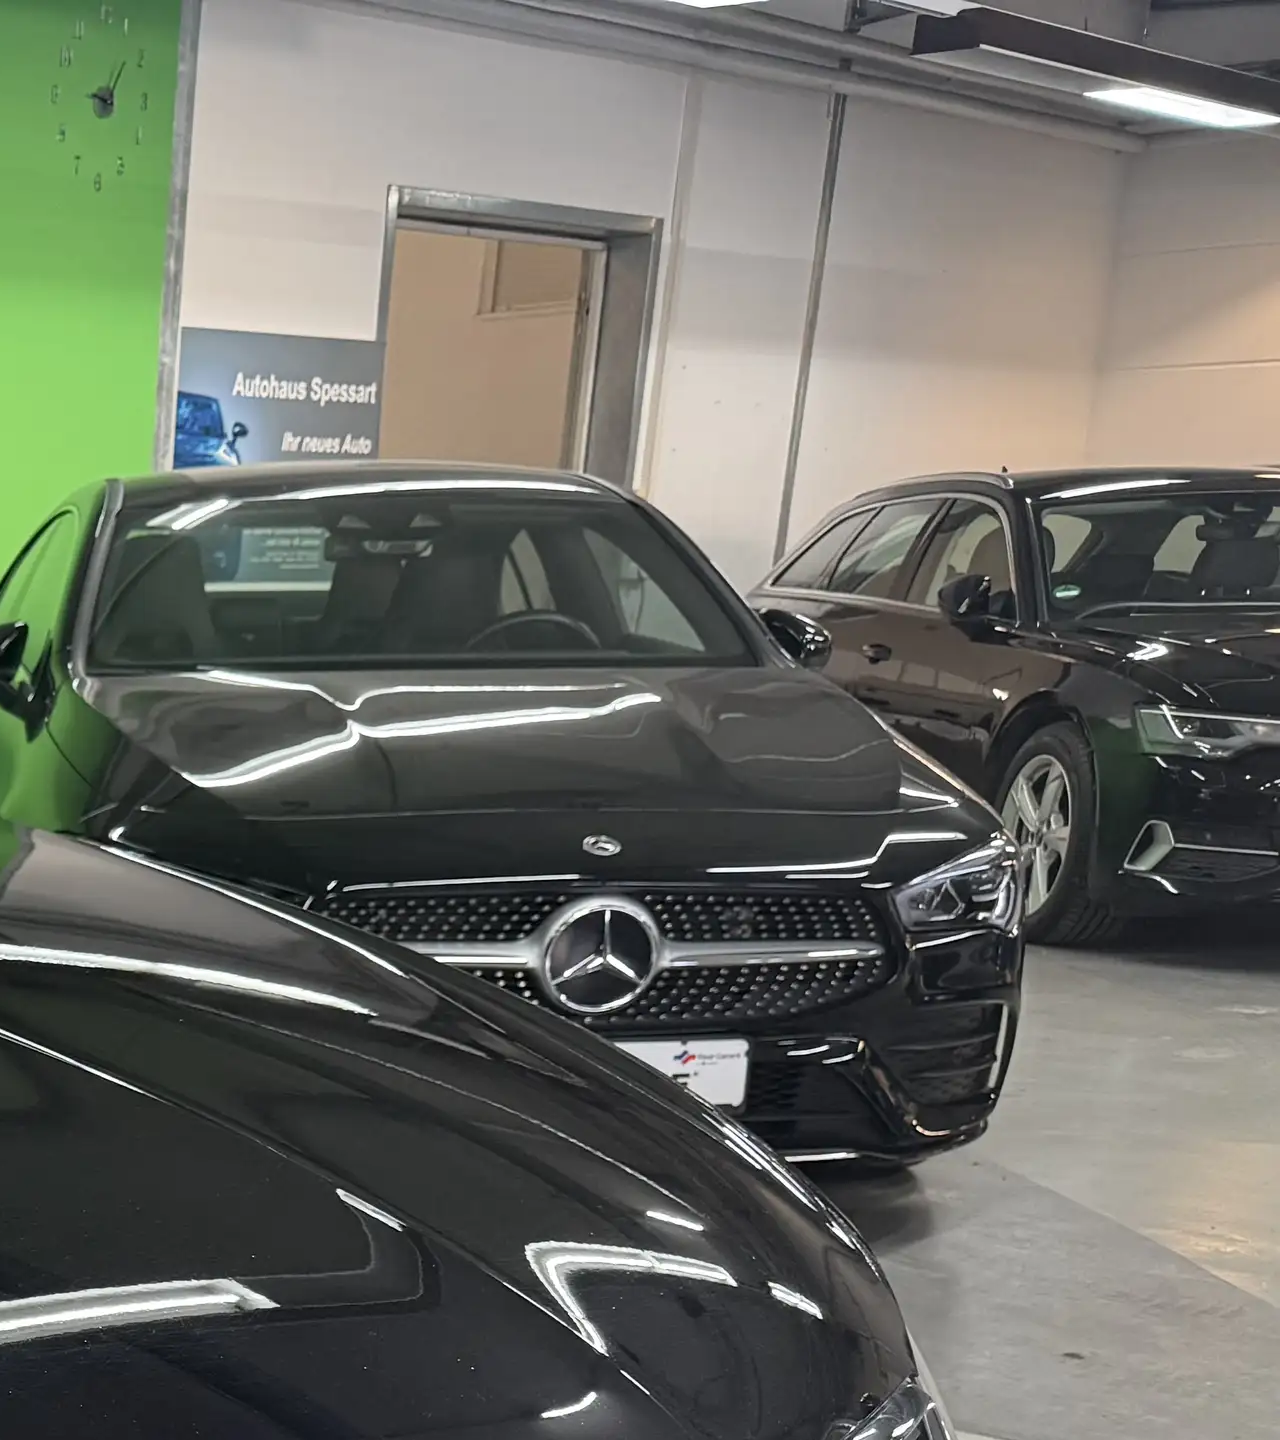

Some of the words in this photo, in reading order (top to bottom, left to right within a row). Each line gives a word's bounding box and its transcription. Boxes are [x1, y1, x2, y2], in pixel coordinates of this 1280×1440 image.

[232, 371, 307, 400] Autohaus
[310, 376, 378, 406] Spessart
[281, 431, 300, 452] Ihr
[301, 435, 340, 454] neues
[341, 433, 372, 455] Auto
